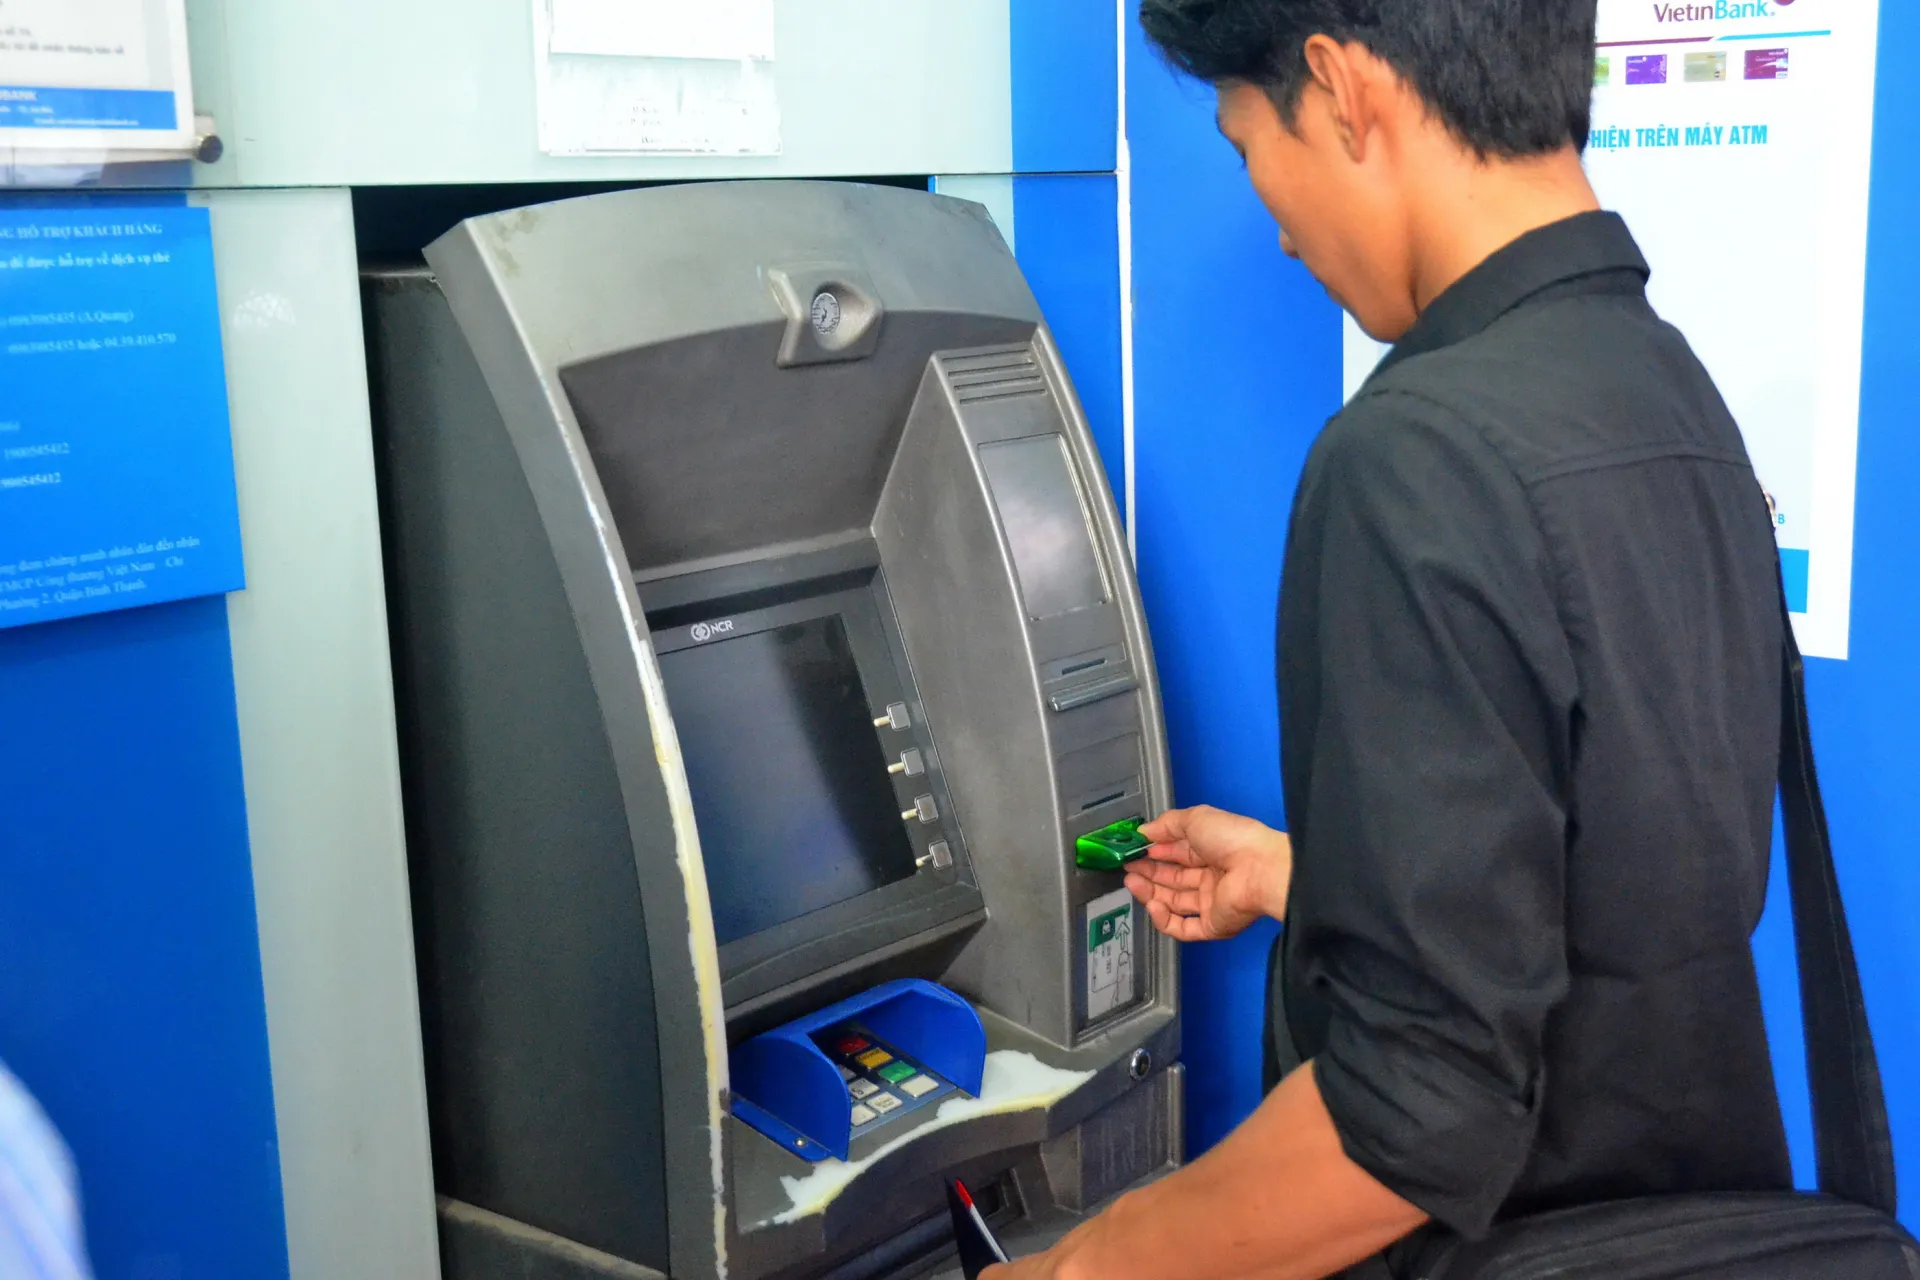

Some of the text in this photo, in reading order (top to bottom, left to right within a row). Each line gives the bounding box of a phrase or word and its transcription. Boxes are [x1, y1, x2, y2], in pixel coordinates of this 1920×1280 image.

[1653, 0, 1769, 23] VietinBank
[1590, 122, 1768, 152] HIỆN TRÊN MÁY ATM
[710, 619, 734, 635] NCR
